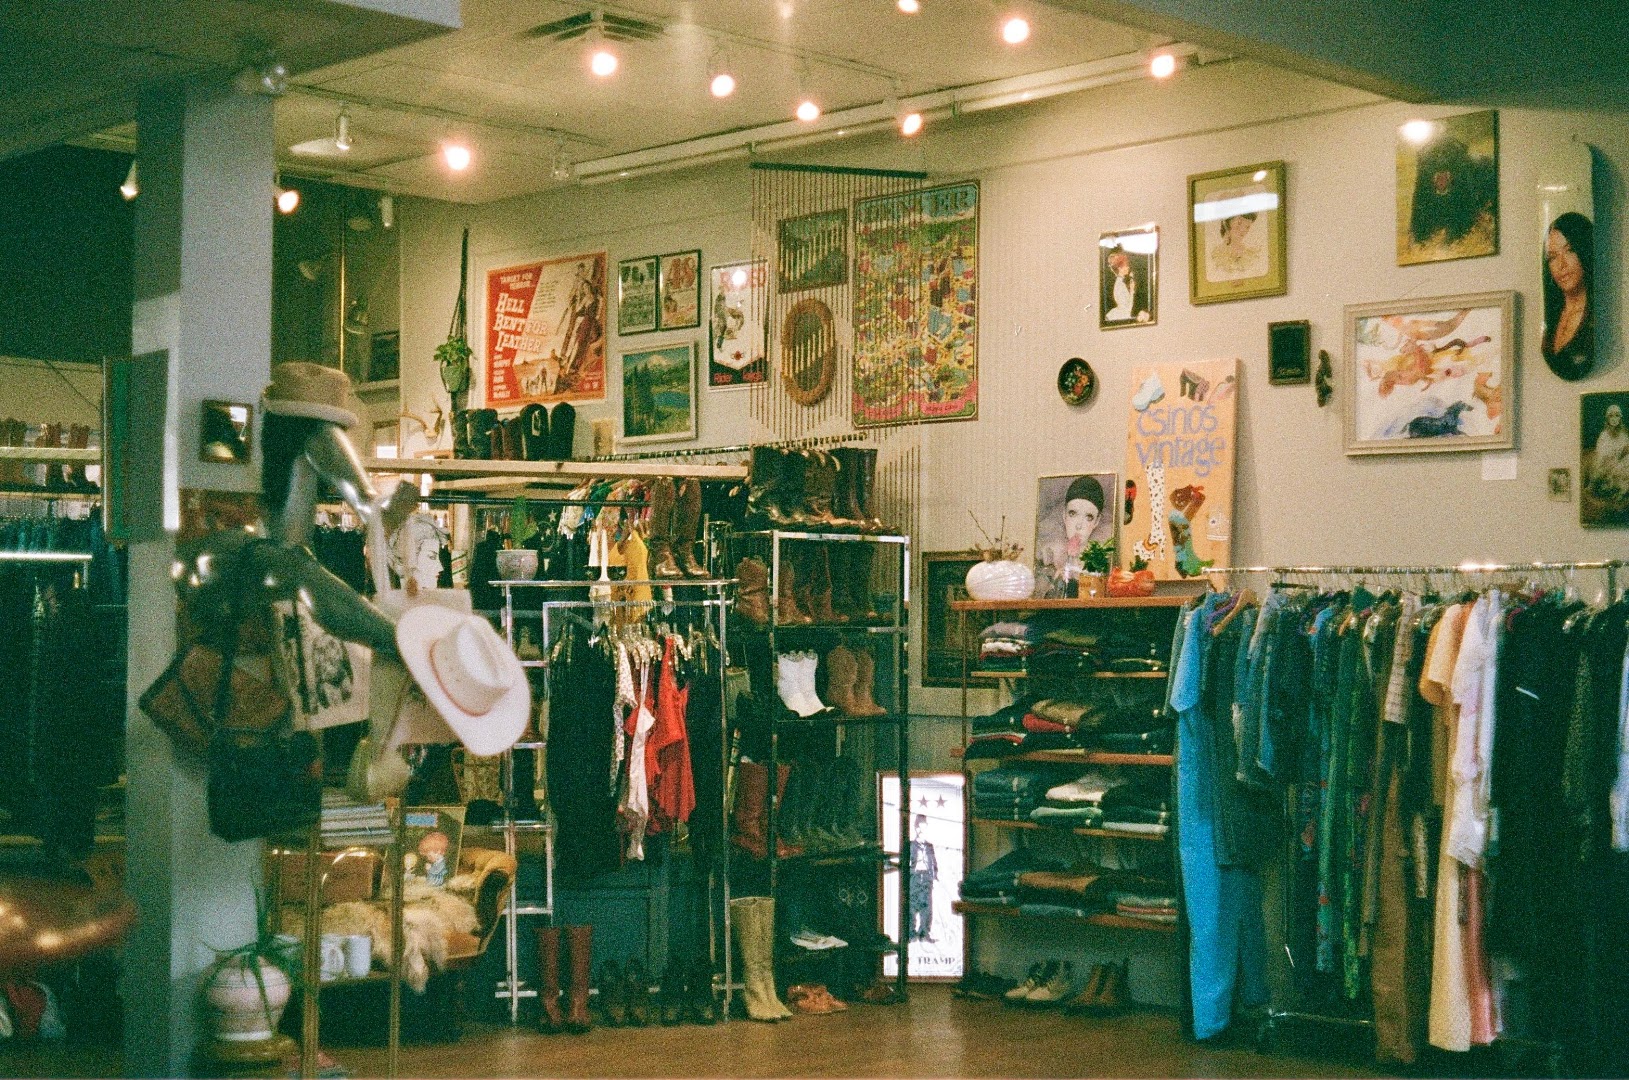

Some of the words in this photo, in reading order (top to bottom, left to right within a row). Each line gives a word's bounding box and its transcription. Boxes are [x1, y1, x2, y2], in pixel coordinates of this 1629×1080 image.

[495, 293, 525, 313] HELL
[493, 313, 526, 332] BENT
[525, 320, 548, 335] FOR
[495, 331, 541, 352] LEATHER
[1136, 435, 1226, 477] vintage
[917, 956, 955, 965] TRAMP
